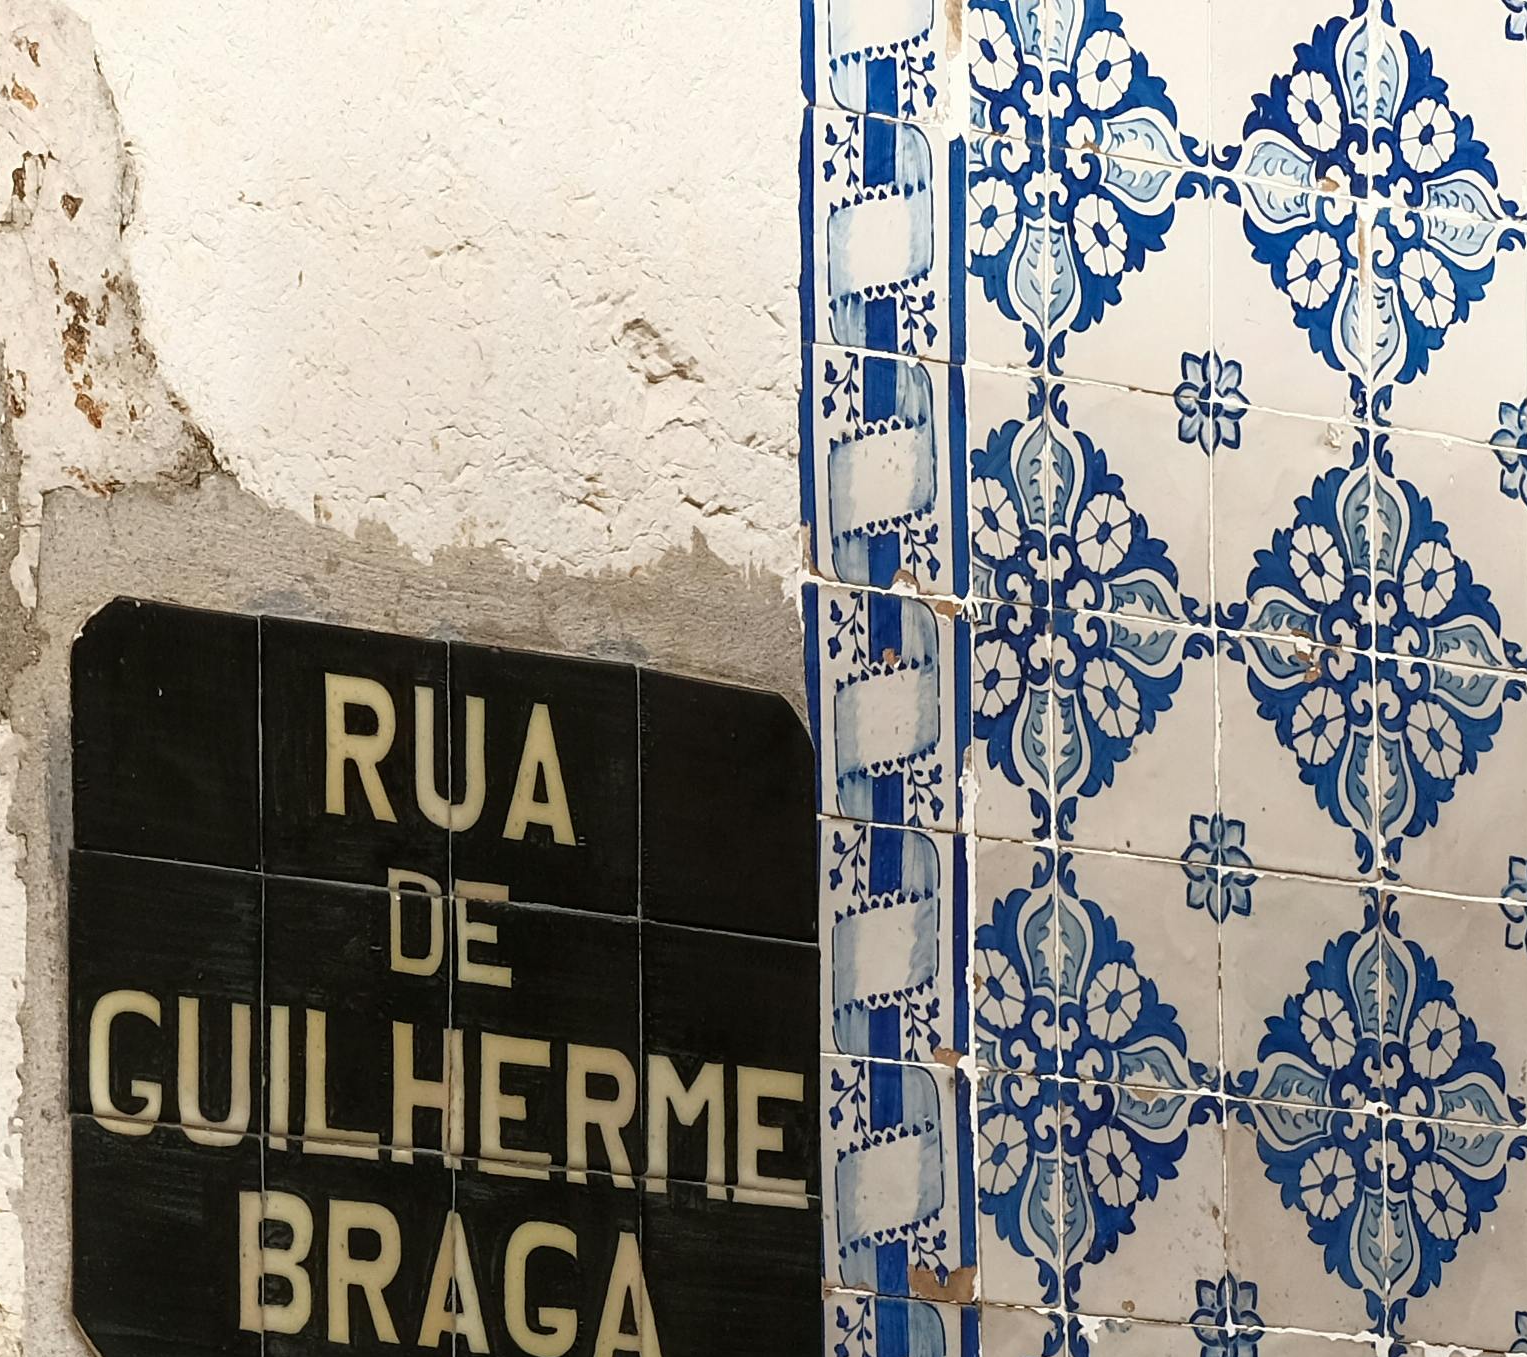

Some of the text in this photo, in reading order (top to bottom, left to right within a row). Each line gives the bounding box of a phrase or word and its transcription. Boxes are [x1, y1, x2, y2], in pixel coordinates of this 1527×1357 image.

[323, 671, 578, 847] RUA
[386, 867, 513, 989] DE
[87, 989, 811, 1210] GUILHERME
